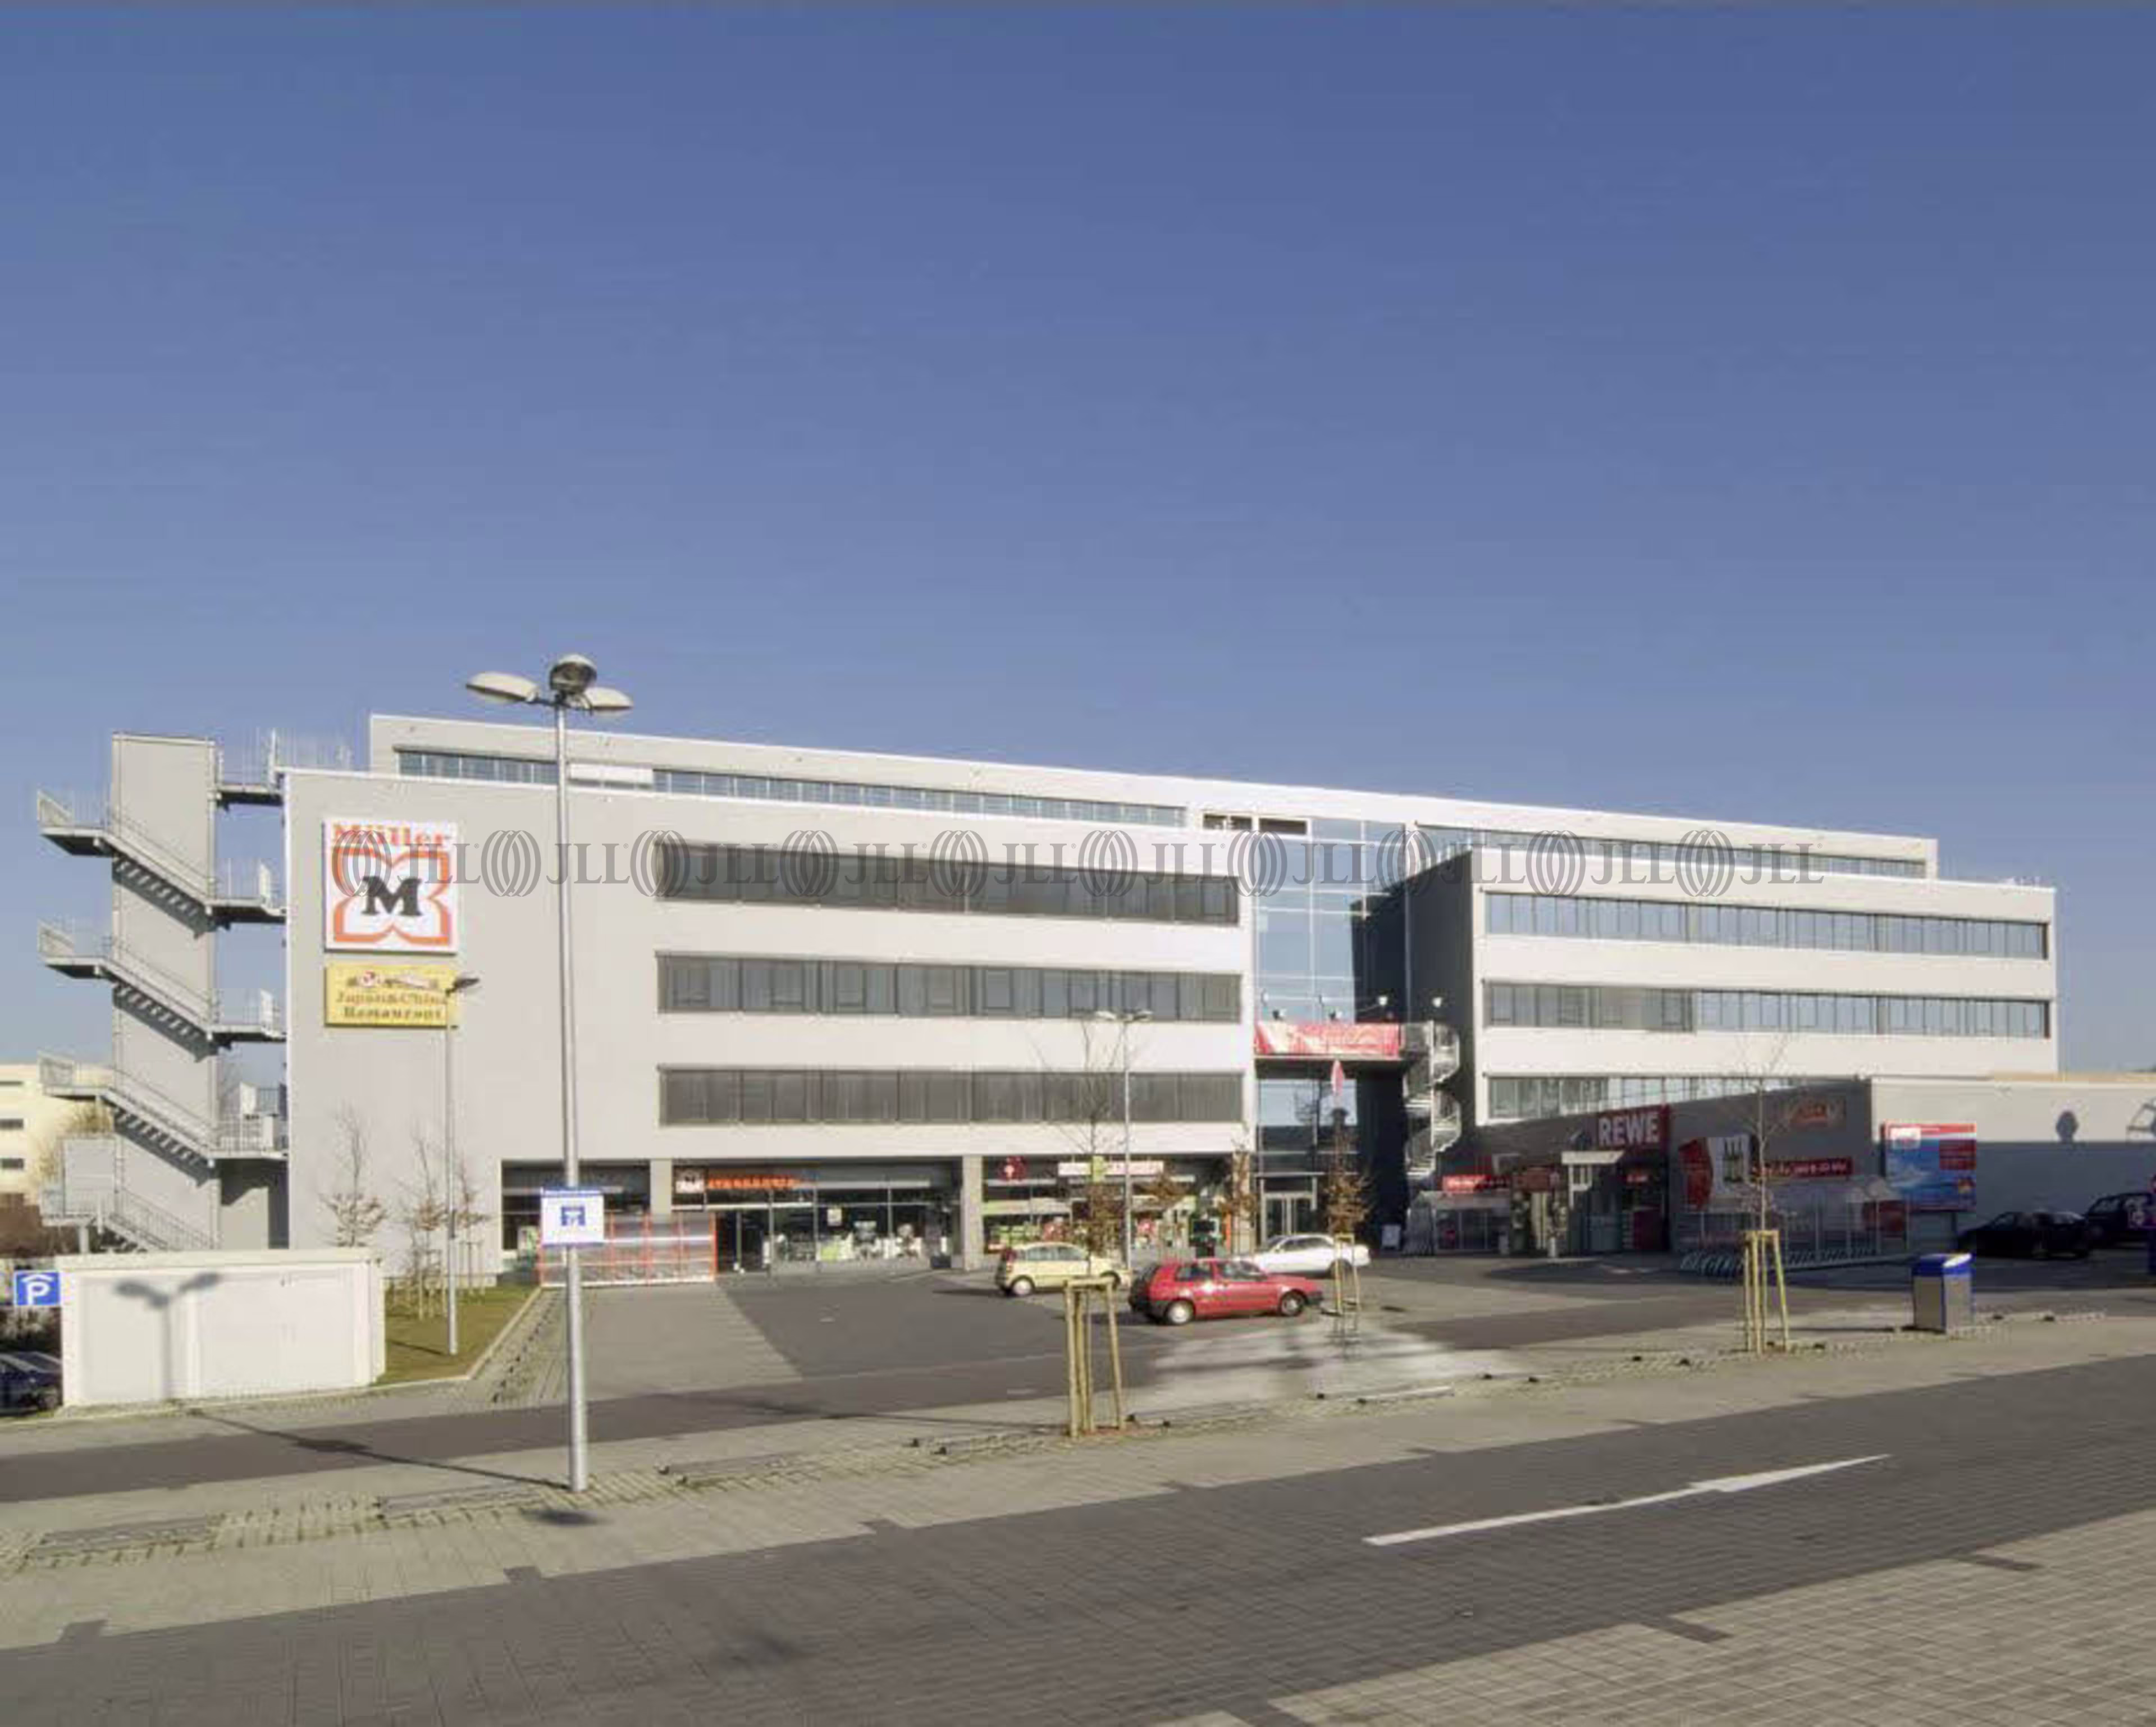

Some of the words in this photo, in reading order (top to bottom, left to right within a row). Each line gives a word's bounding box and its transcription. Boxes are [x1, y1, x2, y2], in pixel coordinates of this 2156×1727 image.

[361, 876, 422, 916] M
[1598, 1111, 1660, 1146] REWE
[27, 1282, 50, 1304] P
